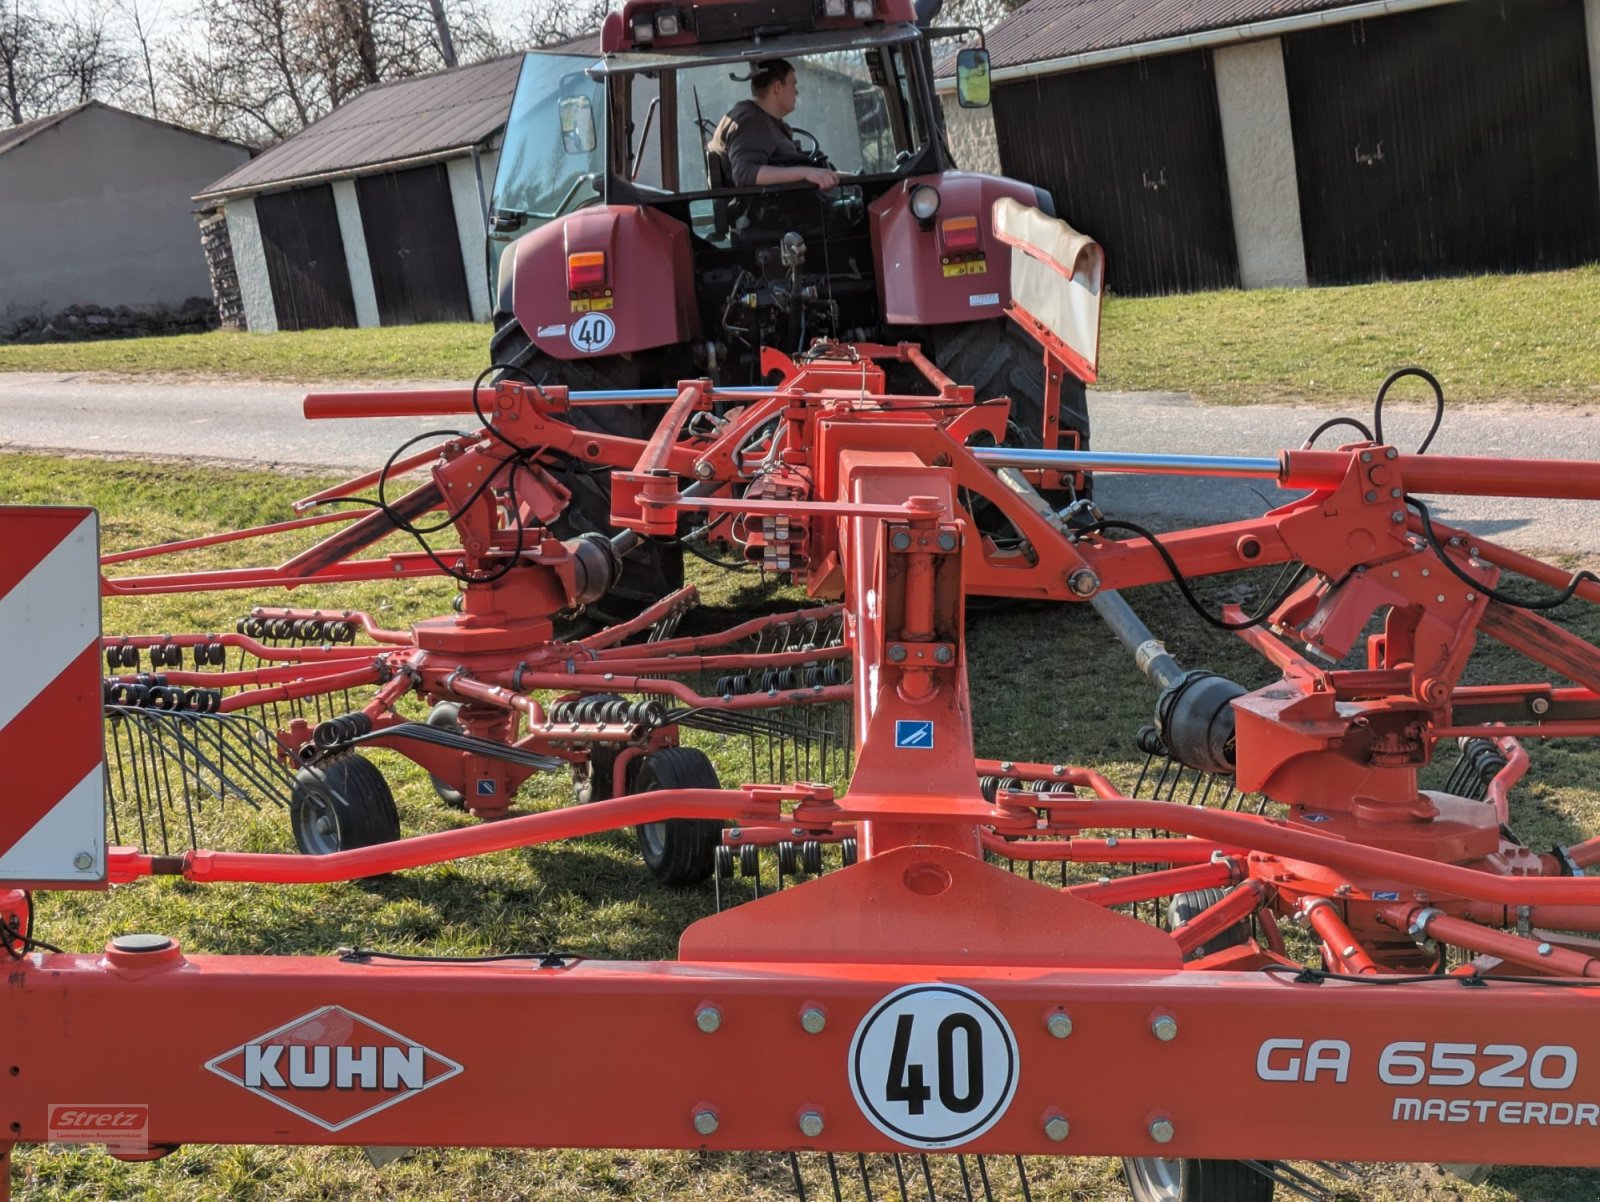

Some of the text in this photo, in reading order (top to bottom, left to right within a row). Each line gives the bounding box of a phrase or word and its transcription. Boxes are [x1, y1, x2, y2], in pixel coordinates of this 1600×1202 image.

[578, 319, 605, 344] 40
[244, 1045, 424, 1088] KUHN
[886, 1012, 984, 1115] 40
[1256, 1038, 1577, 1089] GA 6520
[1392, 1098, 1600, 1126] MASTERDR
